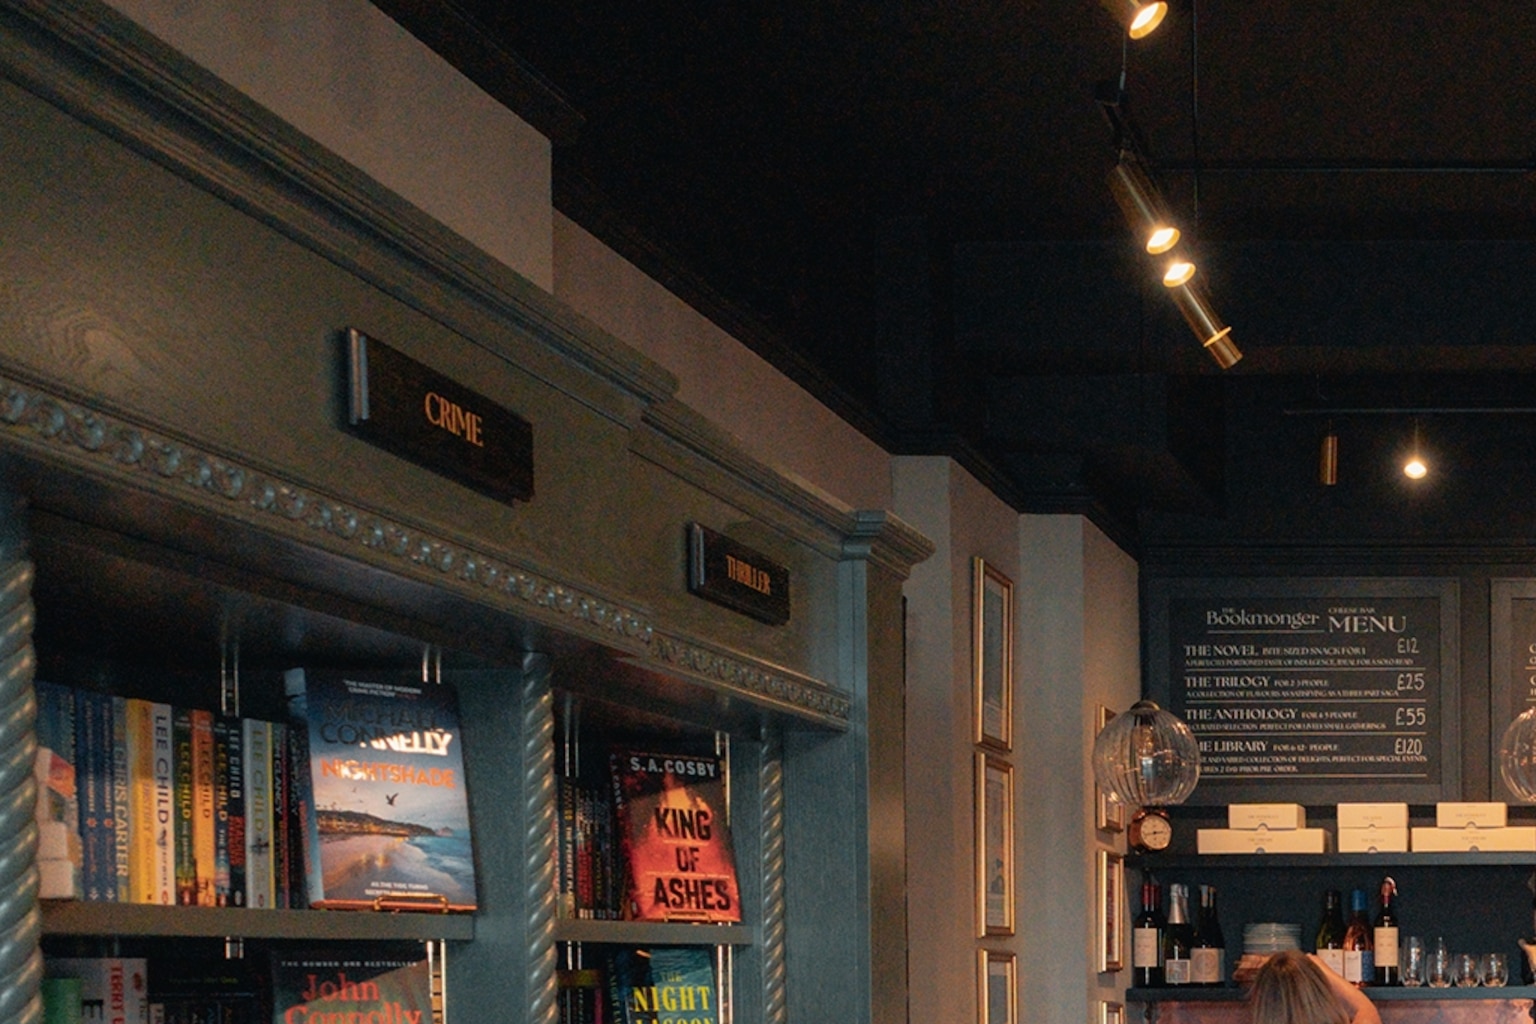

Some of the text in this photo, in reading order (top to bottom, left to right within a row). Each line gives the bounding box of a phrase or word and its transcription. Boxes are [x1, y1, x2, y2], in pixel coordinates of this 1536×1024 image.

[424, 391, 484, 447] CRIME
[726, 554, 771, 595] THRILLER
[1207, 609, 1320, 629] Bookmonger
[1329, 615, 1406, 633] MENU
[1185, 645, 1211, 656] THE
[1213, 645, 1259, 656] NOVEL
[1397, 637, 1420, 654] £12
[1185, 676, 1270, 688] THE TRILOGY
[1397, 672, 1425, 691] £25
[1185, 708, 1298, 720] THE ANTHOLOGY
[1395, 707, 1426, 726] £55
[320, 722, 453, 756] CONNELLY
[1214, 741, 1268, 752] LIBRARY
[1395, 738, 1423, 755] £120
[156, 715, 171, 825] LEE CHILD
[230, 730, 241, 800] LEE CHILD
[320, 758, 457, 789] NIGHTSHADE
[181, 777, 191, 820] CHILD
[218, 778, 229, 822] CHILD
[252, 771, 265, 833] CHILD
[653, 807, 712, 840] KING
[116, 805, 128, 876] CARTER
[675, 846, 700, 873] OF
[653, 878, 731, 911] ASHES
[110, 963, 124, 1014] TERRY
[302, 972, 380, 1002] John
[660, 971, 683, 982] THE
[632, 985, 711, 1013] NIGHT
